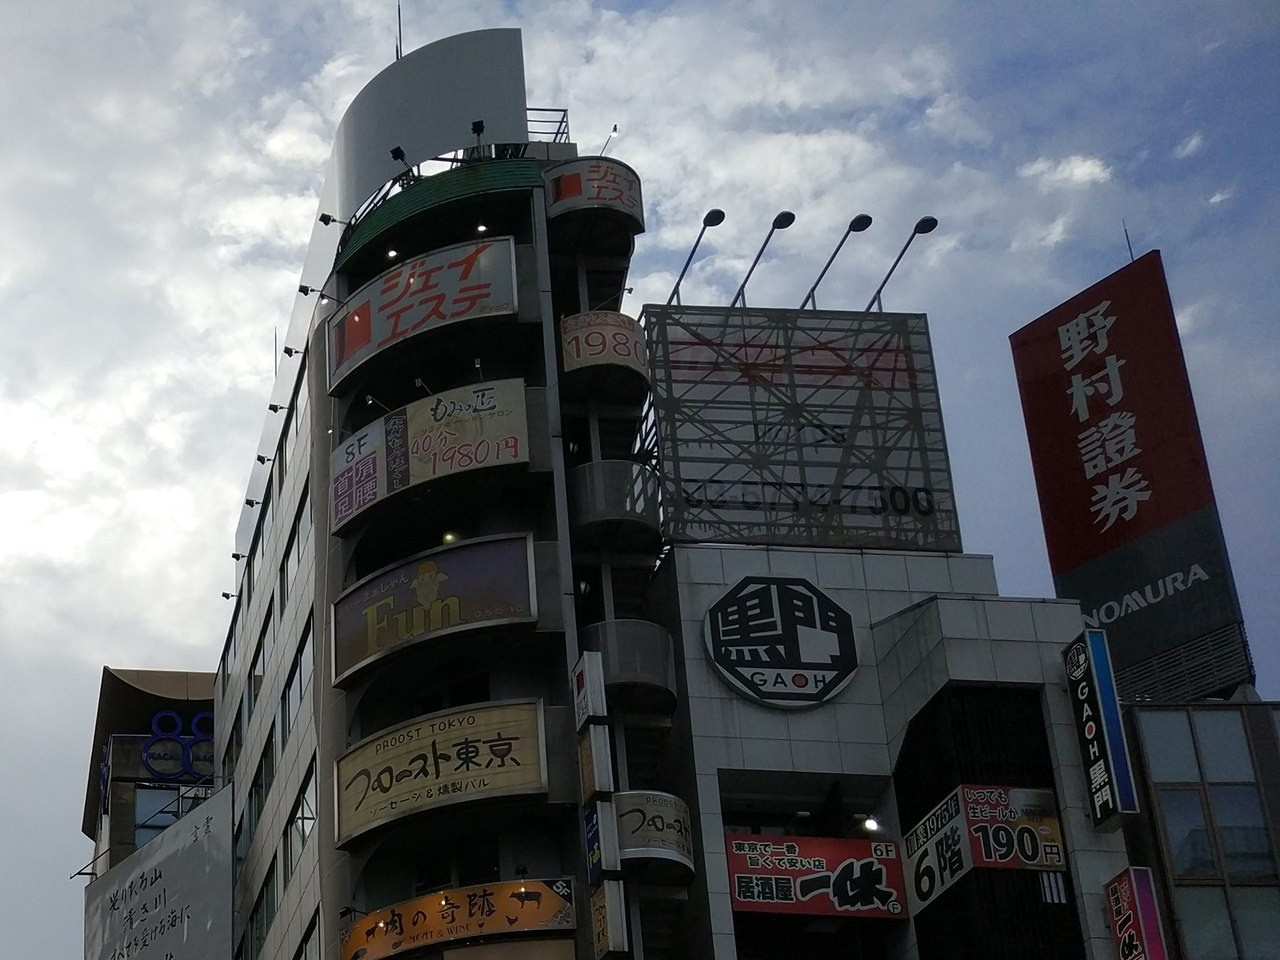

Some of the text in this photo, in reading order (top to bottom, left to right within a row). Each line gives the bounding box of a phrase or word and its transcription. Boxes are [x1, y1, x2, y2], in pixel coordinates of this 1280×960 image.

[378, 244, 494, 313] ジェイ
[377, 283, 492, 349] エステ
[1057, 299, 1153, 535] 野村證券
[344, 434, 369, 464] 8F
[431, 435, 520, 476] 1980円
[1082, 562, 1211, 629] NOMURA
[362, 593, 467, 651] Fun
[750, 671, 827, 689] GAOH
[375, 715, 476, 756] PROOST TOKYO
[964, 788, 1009, 805] いつでも
[1088, 759, 1115, 820] 黒門
[732, 840, 800, 857] 東京で一番
[872, 843, 895, 858] 6F
[914, 825, 964, 903] 6階
[970, 822, 1063, 866] 190円
[552, 879, 572, 897] 5F
[734, 857, 898, 911] 居酒屋 一休
[384, 890, 497, 936] 肉の奇跡
